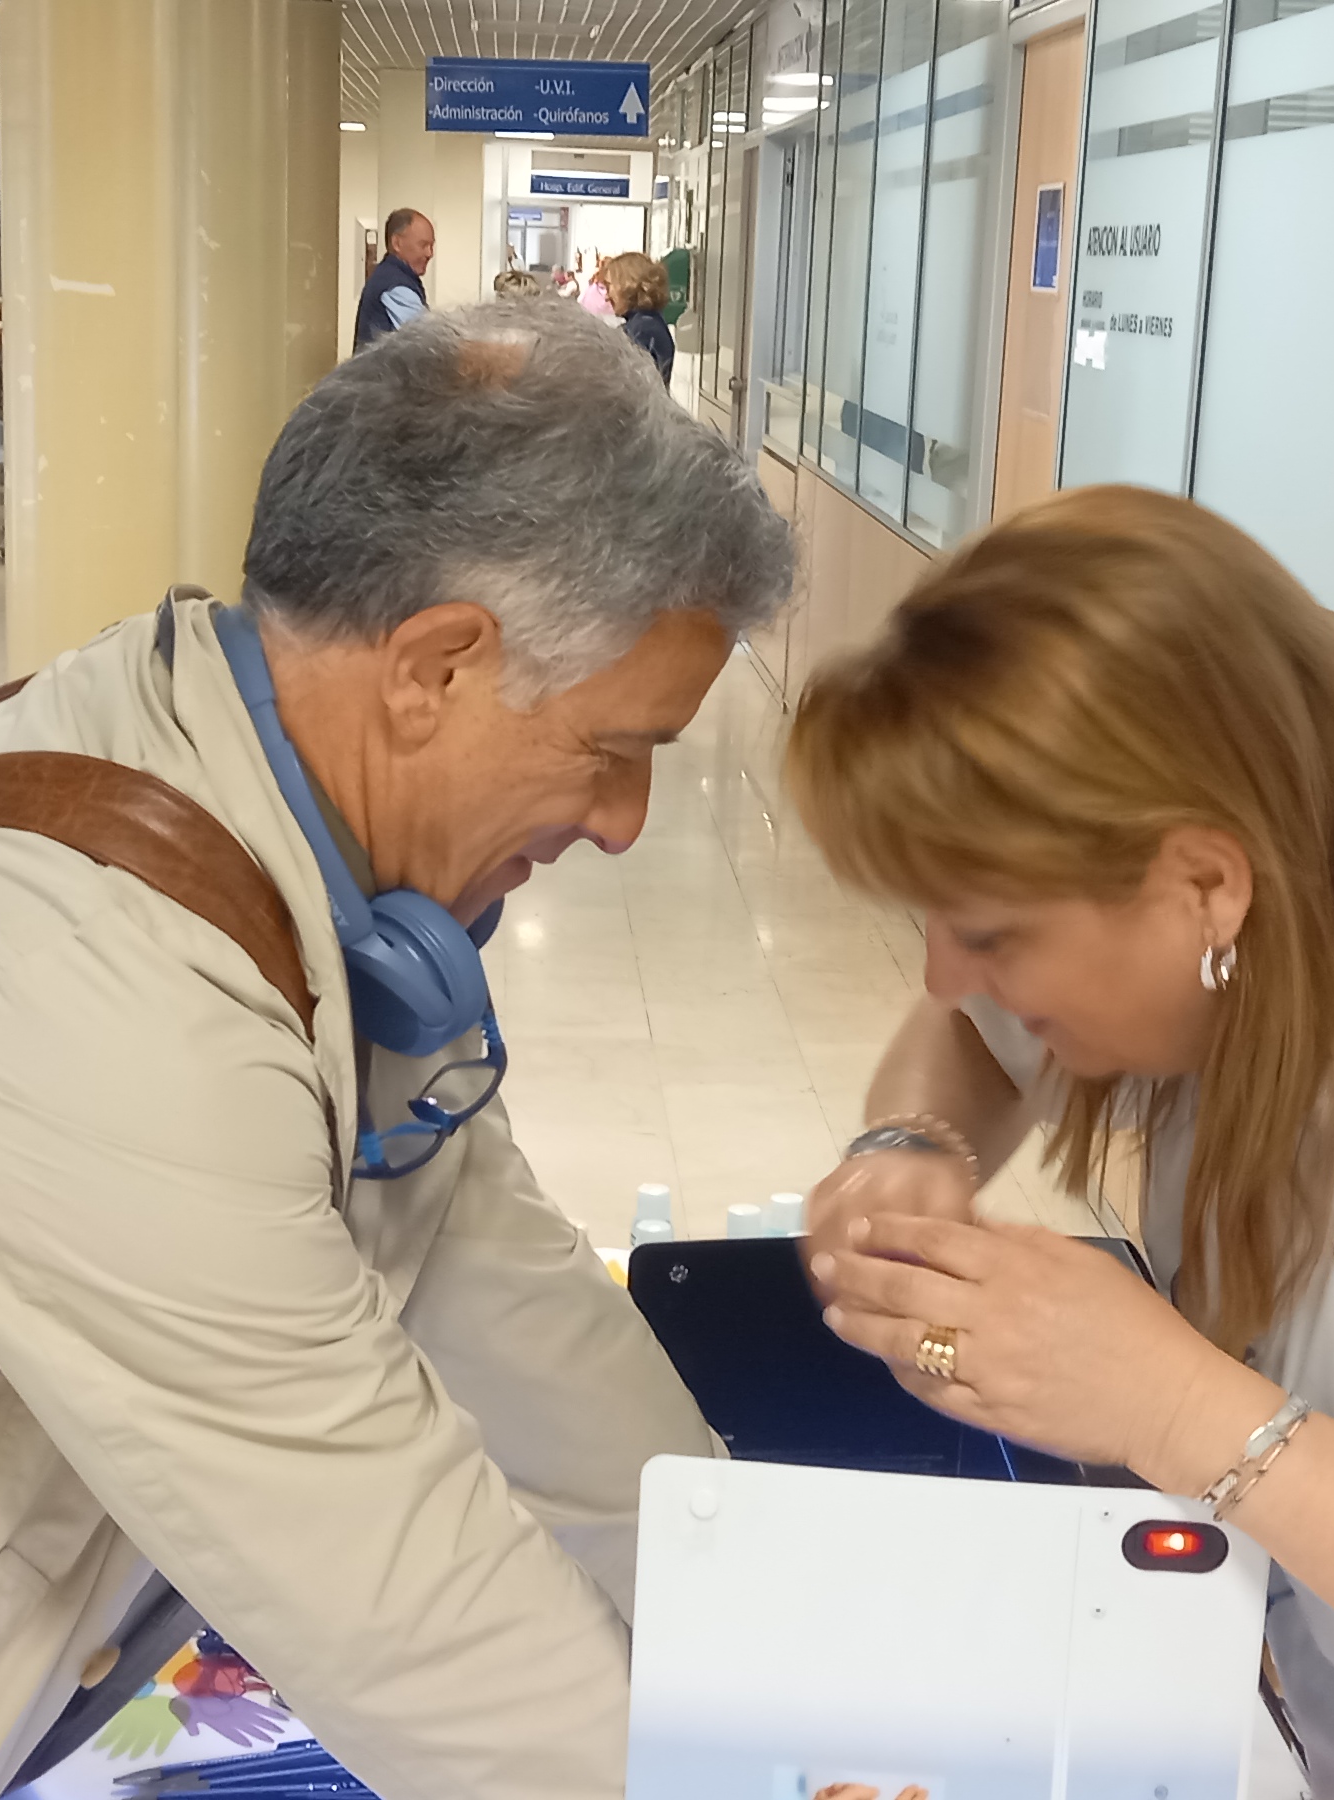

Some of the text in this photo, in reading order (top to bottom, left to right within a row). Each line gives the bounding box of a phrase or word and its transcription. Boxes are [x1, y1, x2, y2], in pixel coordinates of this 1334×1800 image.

[587, 183, 621, 195] General
[1119, 226, 1127, 256] AL
[1129, 224, 1161, 256] USUARIO
[1118, 313, 1138, 333] LUNES
[1145, 316, 1173, 338] VIERNES
